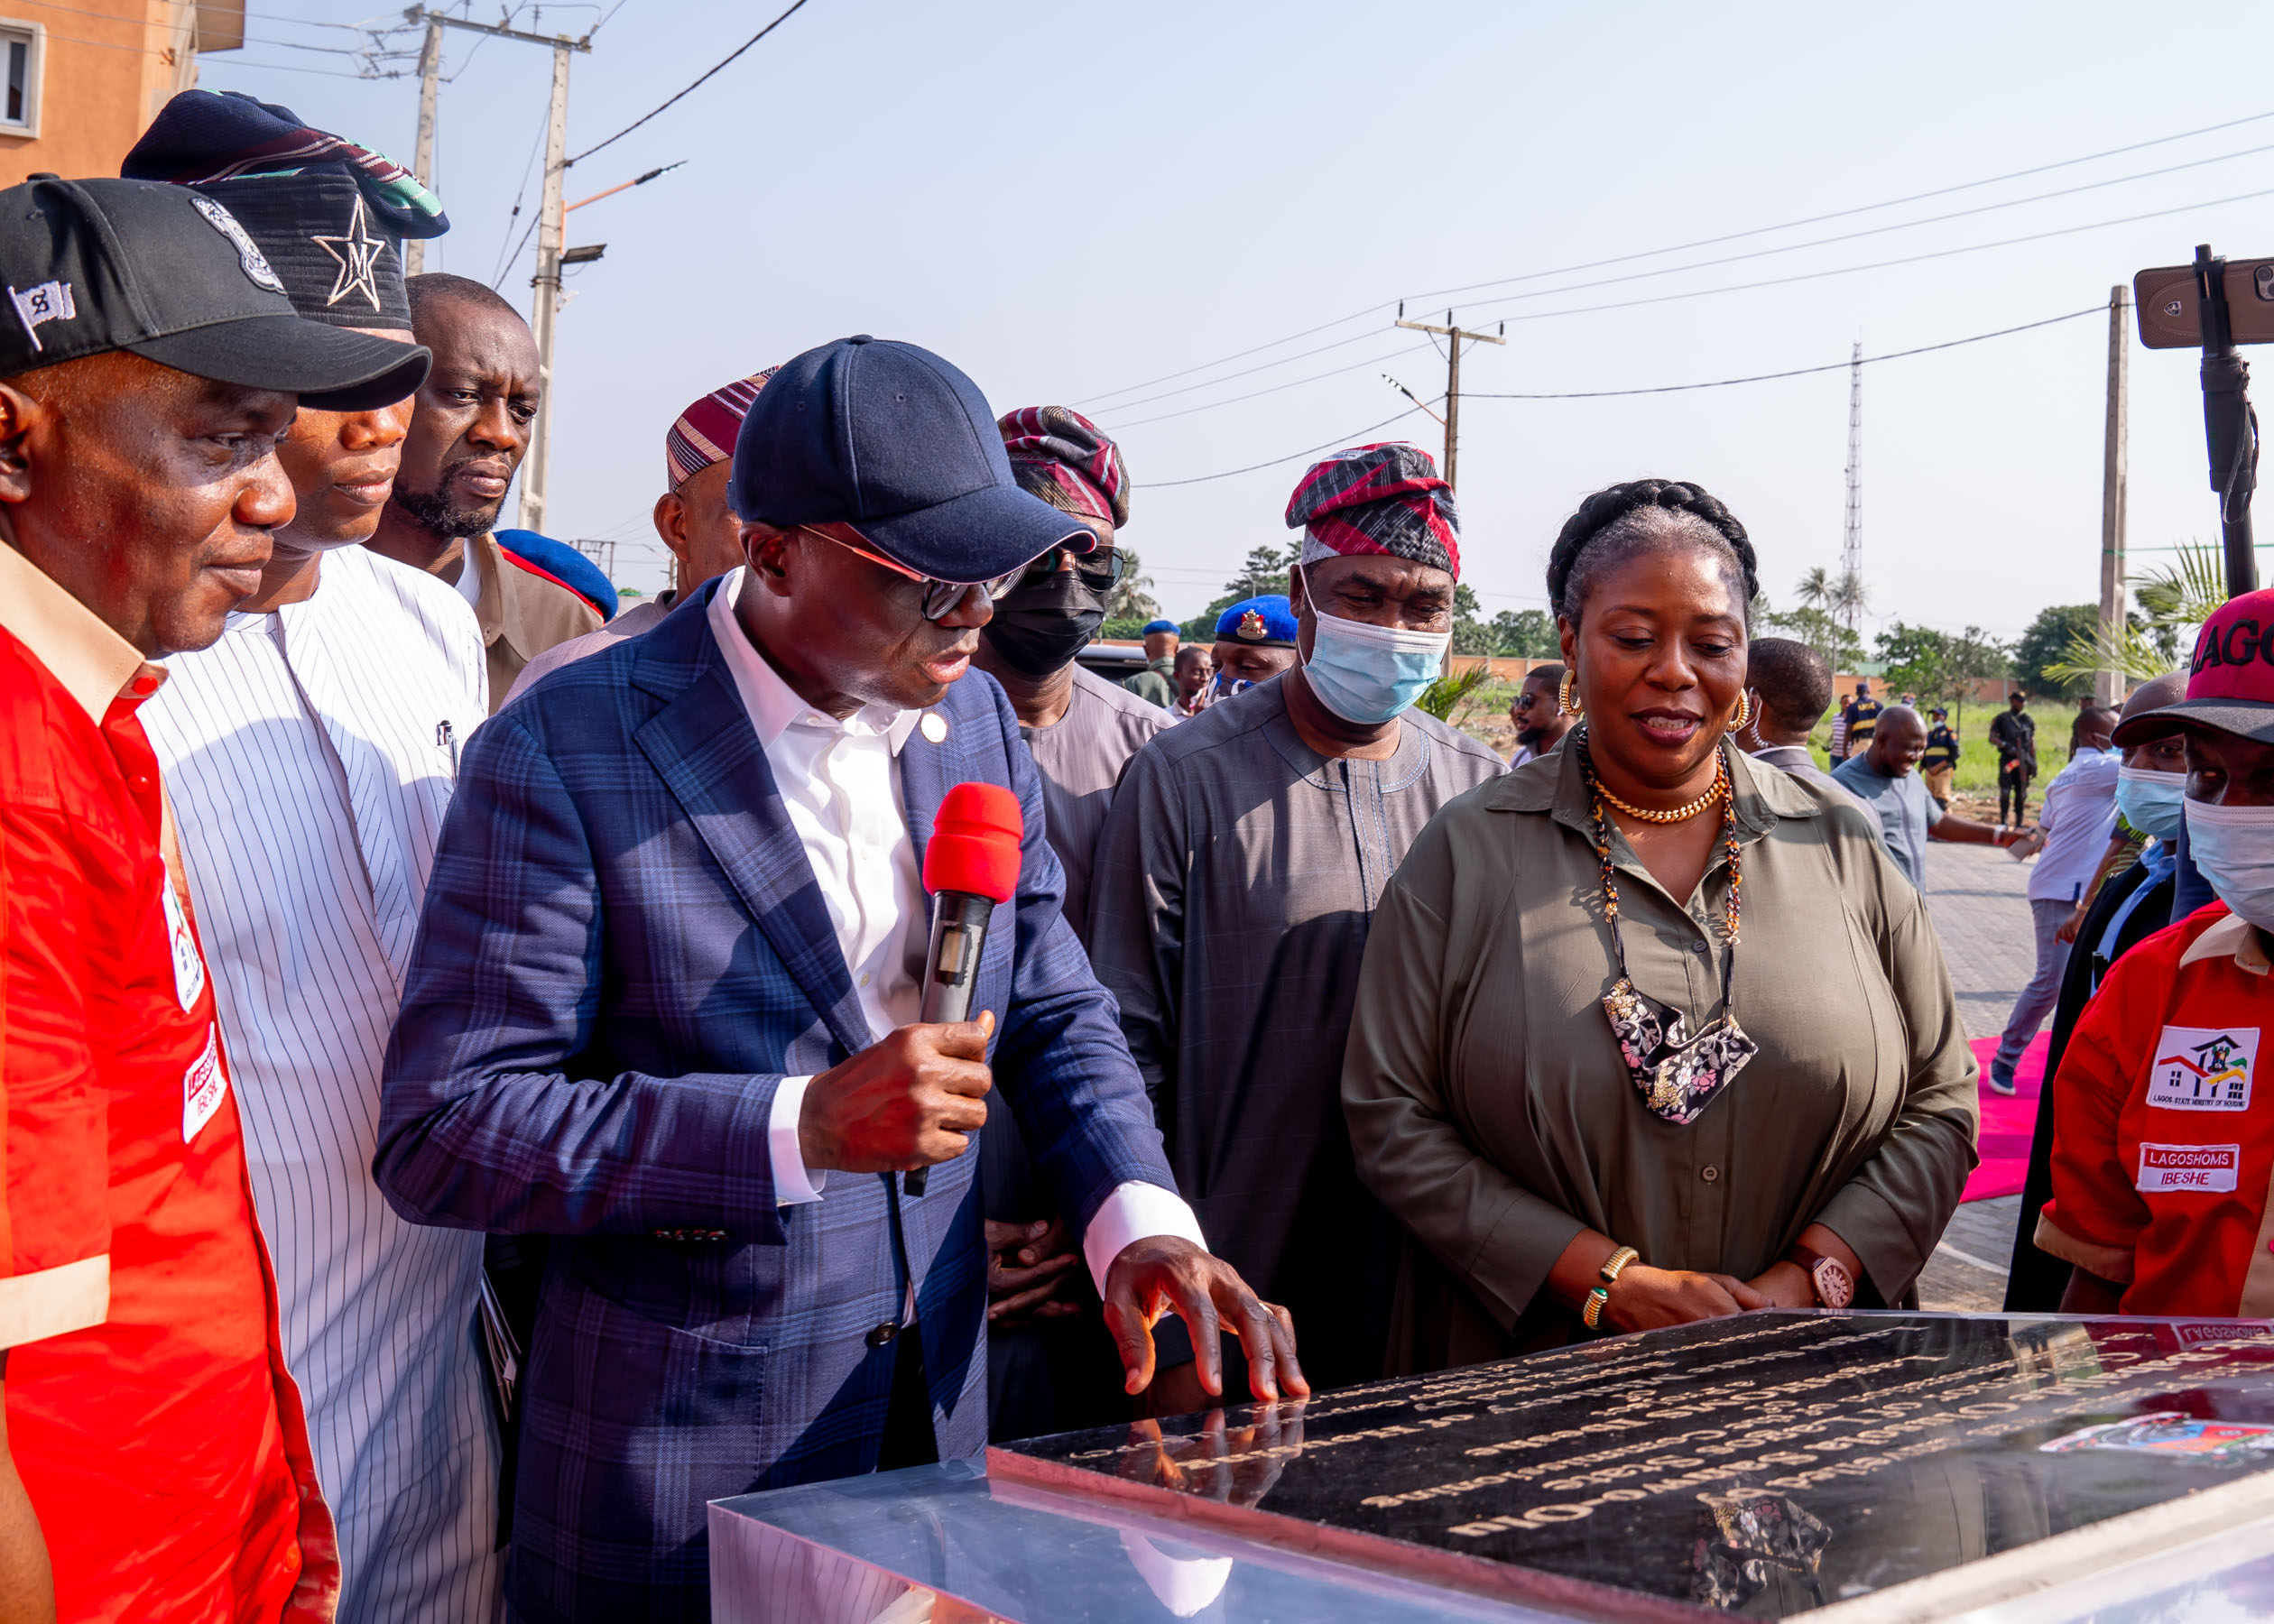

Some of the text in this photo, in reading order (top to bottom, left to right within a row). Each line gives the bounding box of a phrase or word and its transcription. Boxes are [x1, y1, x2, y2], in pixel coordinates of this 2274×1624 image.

[2149, 1151, 2230, 1166] LAGOSHOMS
[2160, 1171, 2211, 1186] IBESHE
[1776, 1315, 1852, 1330] Lagos
[1719, 1329, 1781, 1342] State
[1483, 1363, 1518, 1371] of
[1522, 1353, 1572, 1364] day
[1413, 1361, 1675, 1411] Supervised by
[1421, 1369, 1530, 1390] on this
[2009, 1352, 2227, 1401] Babajide
[1175, 1325, 1928, 1469] Lagos State Ministry of Housing
[1409, 1378, 1530, 1400] Property
[1611, 1389, 1657, 1402] of
[1465, 1355, 1947, 1455] LagosHOMS Ibeshe
[1590, 1386, 1735, 1416] Project
[1742, 1399, 1821, 1414] of
[1773, 1402, 1838, 1416] of
[1858, 1401, 1922, 1418] of
[1724, 1414, 1795, 1429] the
[1805, 1402, 2020, 1450] Olusola
[1696, 1415, 1880, 1453] Lagos
[1363, 1429, 1725, 1507] Commissioning
[1542, 1454, 1703, 1490] State
[1766, 1435, 1974, 1488] unveiled
[1451, 1451, 1816, 1535] Sanwo-Olu
[1696, 1485, 1784, 1510] by
